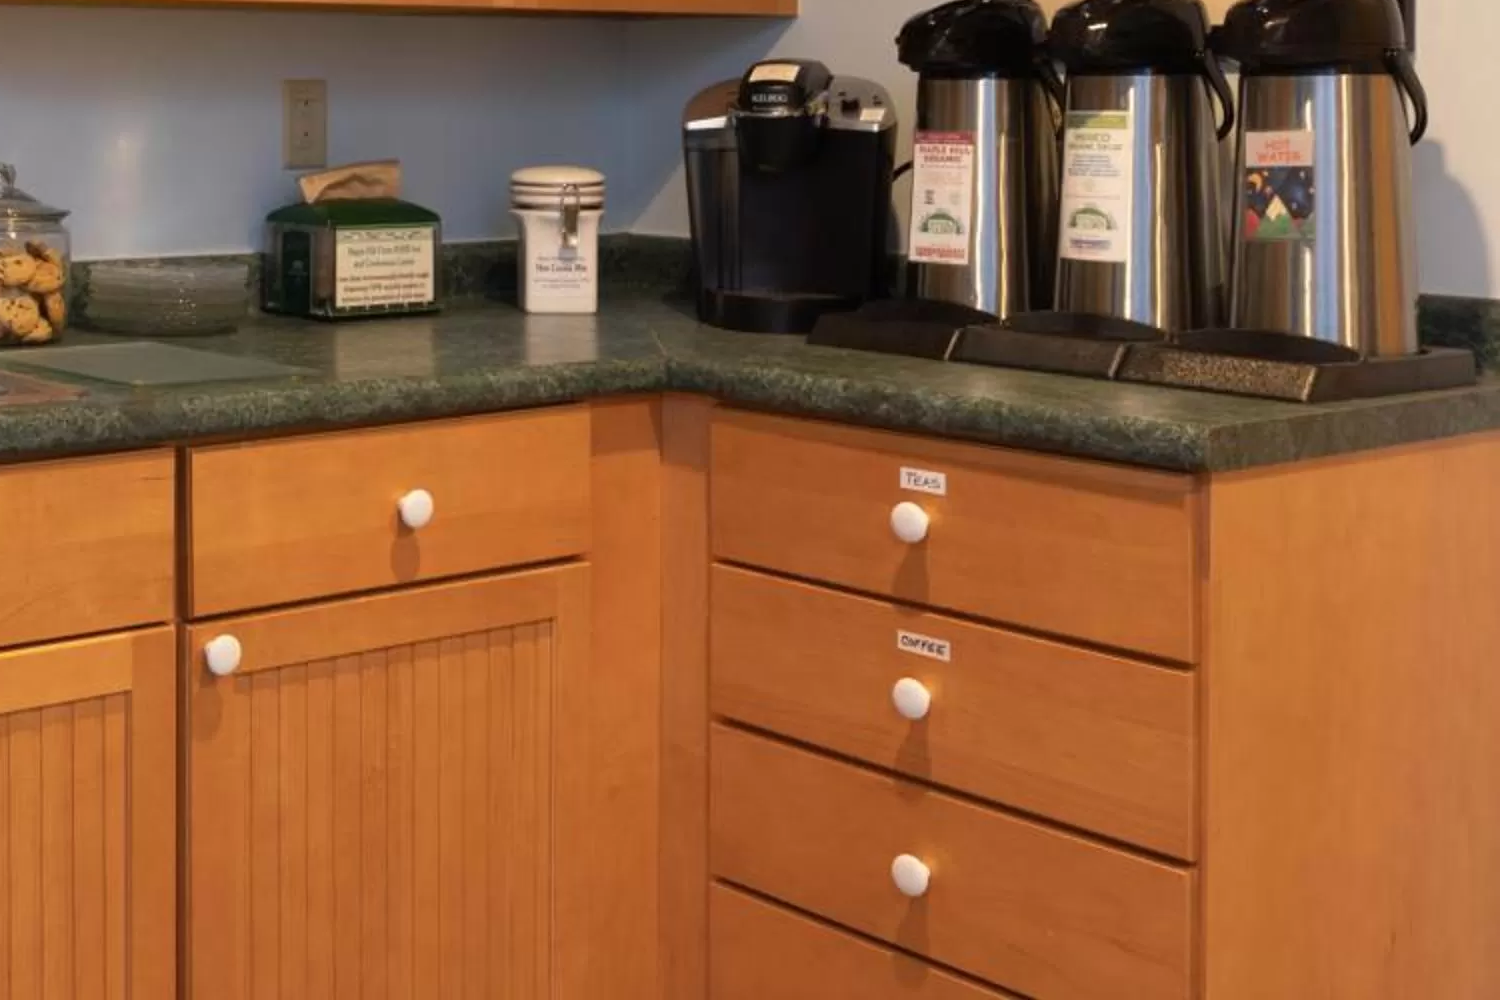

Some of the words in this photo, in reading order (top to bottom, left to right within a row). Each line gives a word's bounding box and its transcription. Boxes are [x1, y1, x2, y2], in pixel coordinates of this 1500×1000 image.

[1265, 138, 1289, 150] HOT
[1257, 150, 1304, 163] WATER
[905, 471, 942, 489] TEAS
[900, 635, 947, 656] COFFEE
